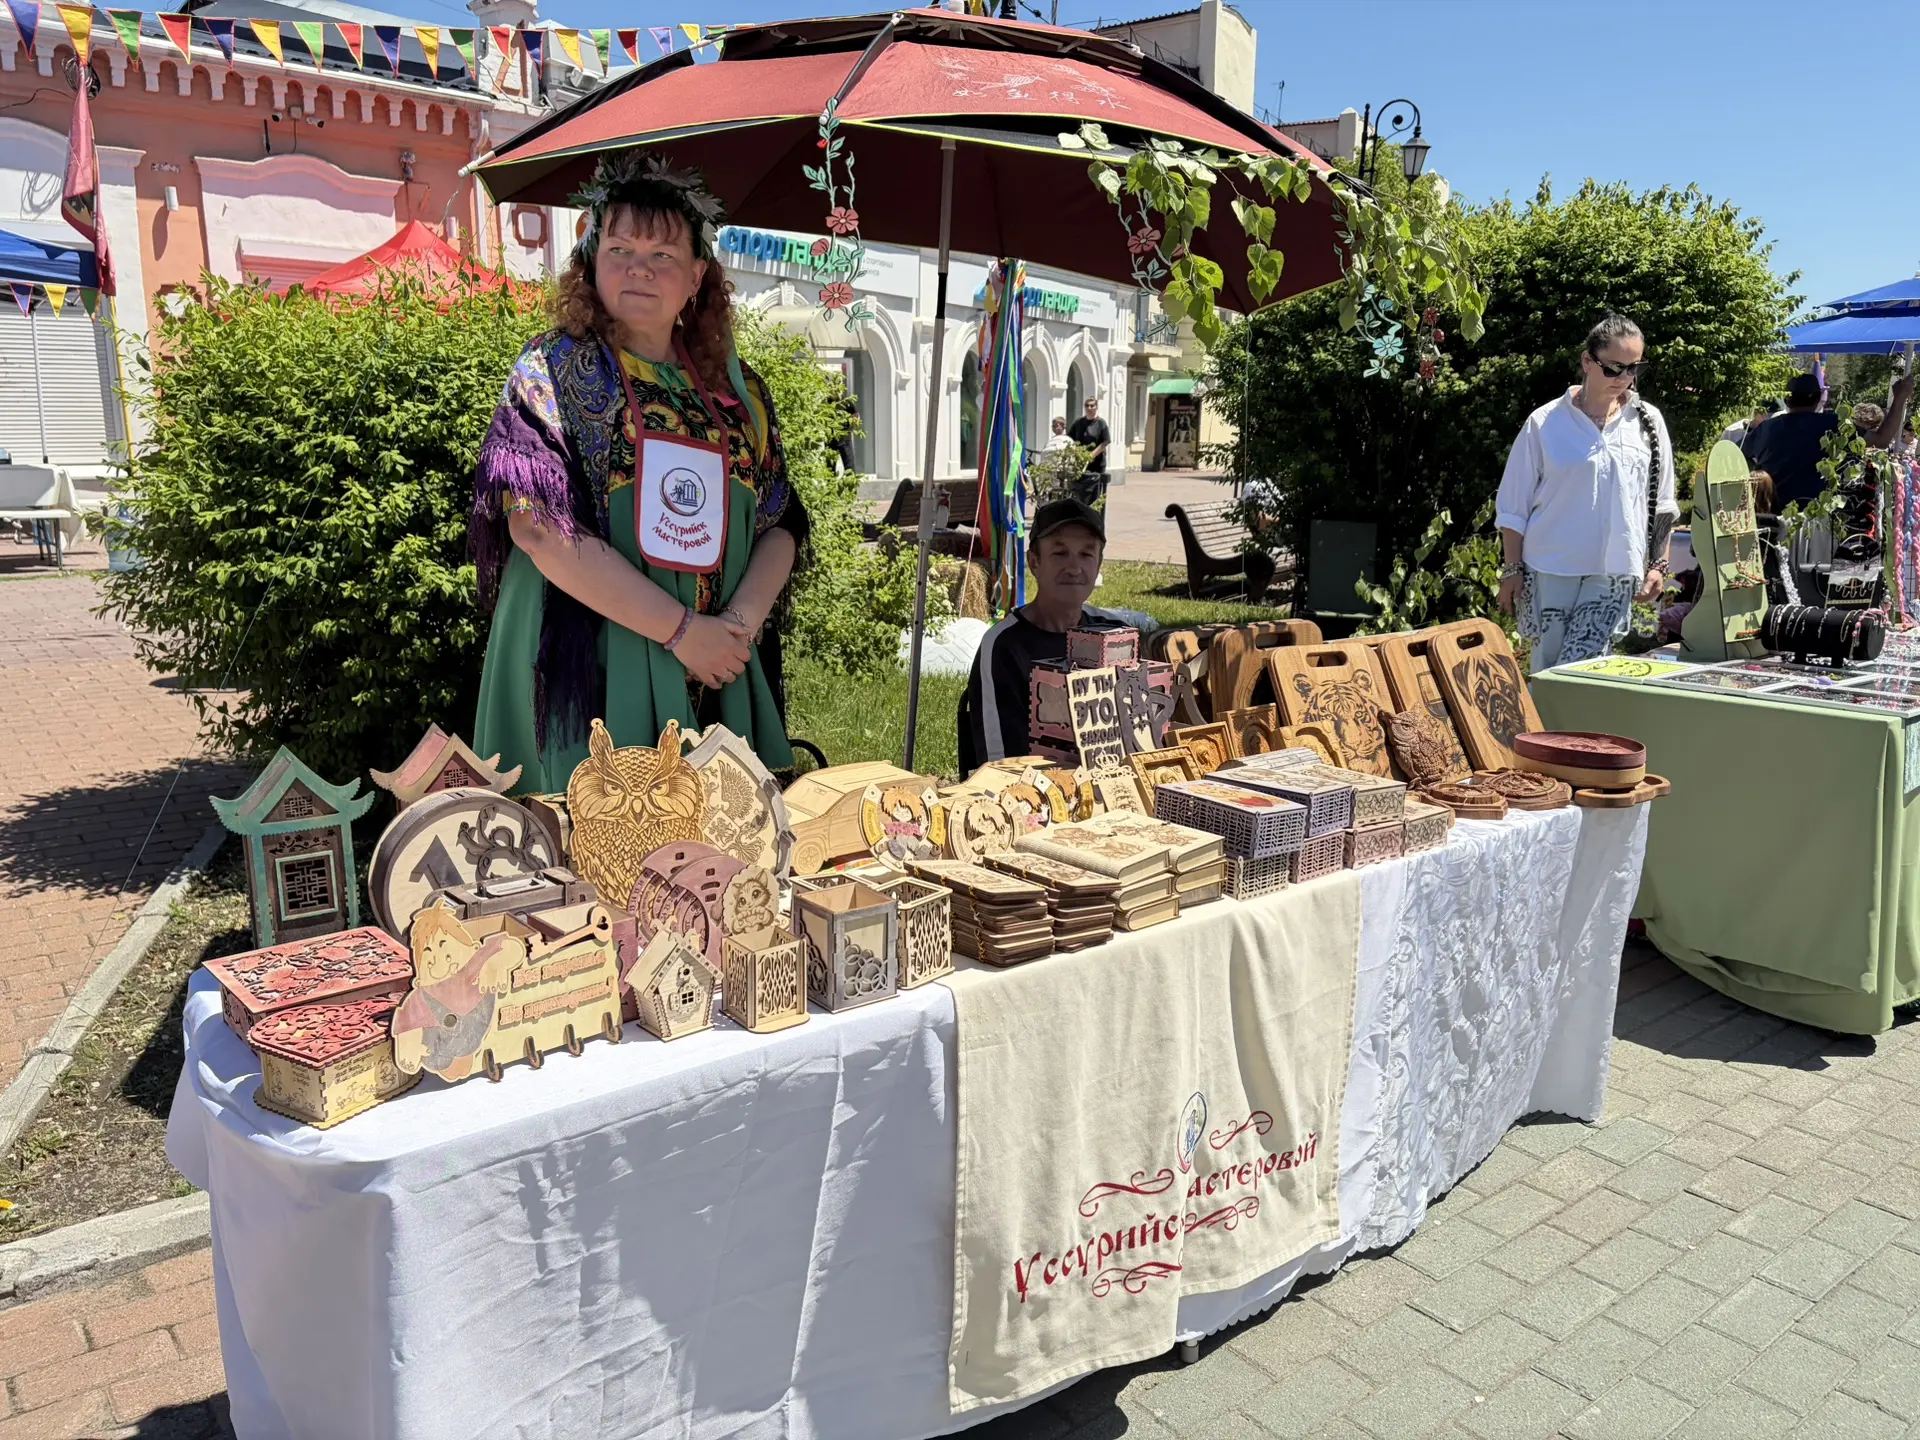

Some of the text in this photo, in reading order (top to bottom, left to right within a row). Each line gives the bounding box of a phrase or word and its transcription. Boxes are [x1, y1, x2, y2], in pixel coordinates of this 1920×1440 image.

[659, 512, 707, 537] Уссурийск
[1072, 674, 1114, 697] НУ ТЫ
[1074, 697, 1119, 729] ЭТО,
[1080, 726, 1122, 747] ЗАХОДИ
[1013, 1132, 1318, 1304] Уссурийс астеровй
